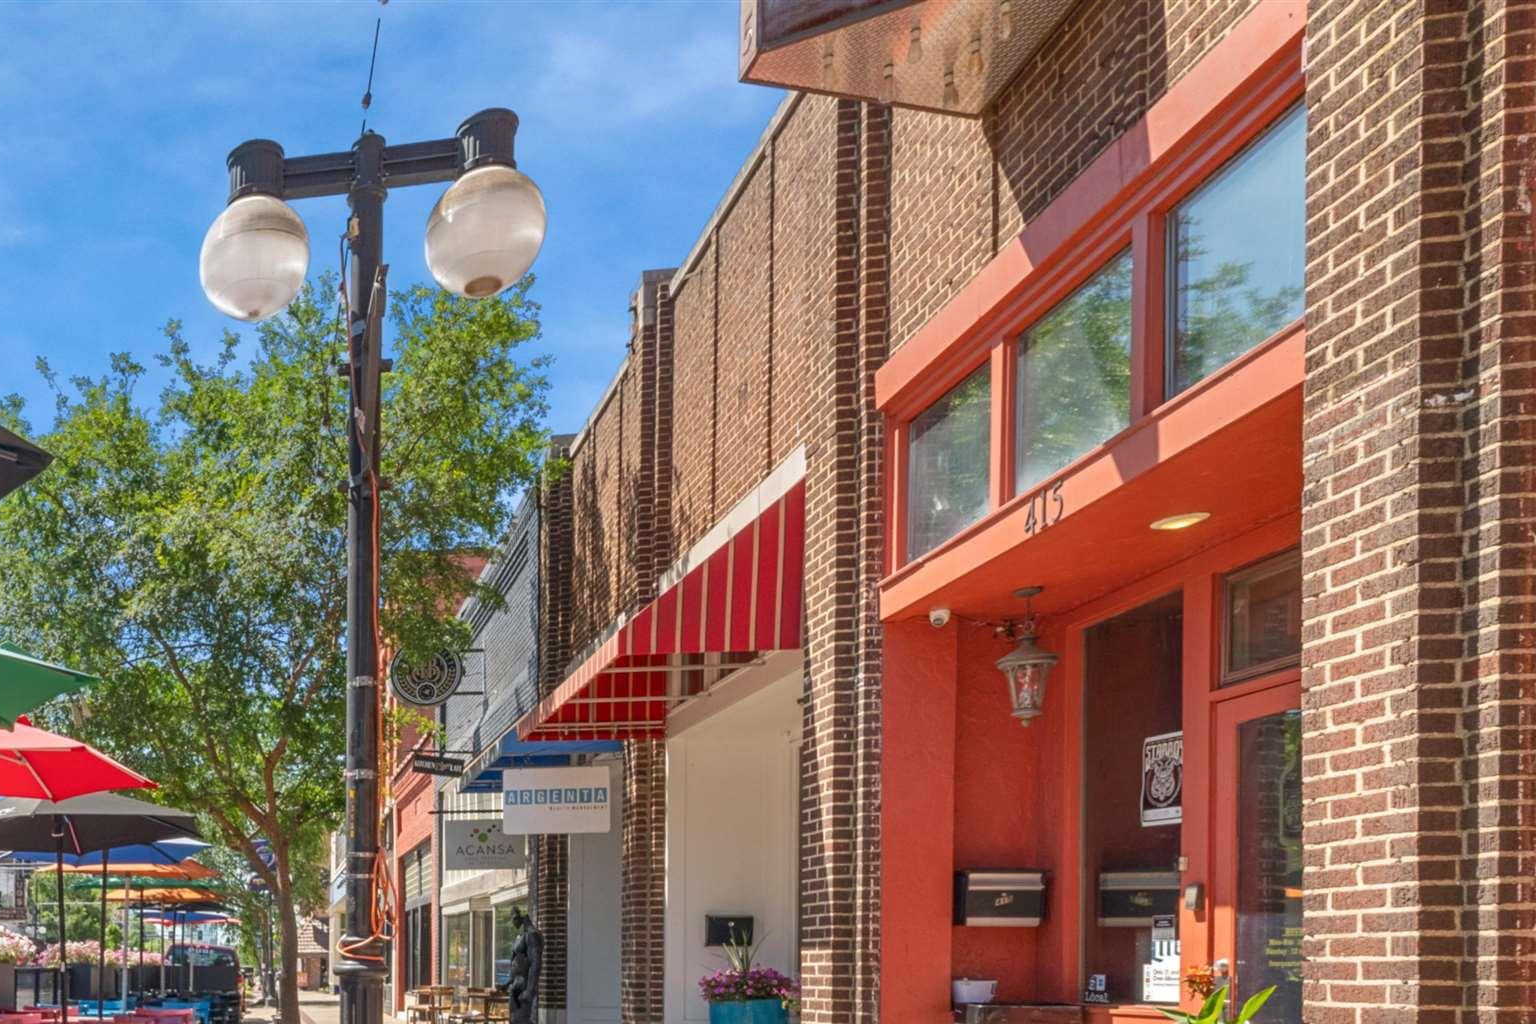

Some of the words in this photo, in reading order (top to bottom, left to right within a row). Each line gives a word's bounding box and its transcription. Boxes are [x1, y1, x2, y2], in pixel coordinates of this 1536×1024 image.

[1025, 478, 1063, 536] 415
[506, 788, 607, 804] ARGENTA
[456, 844, 516, 856] ACANSA
